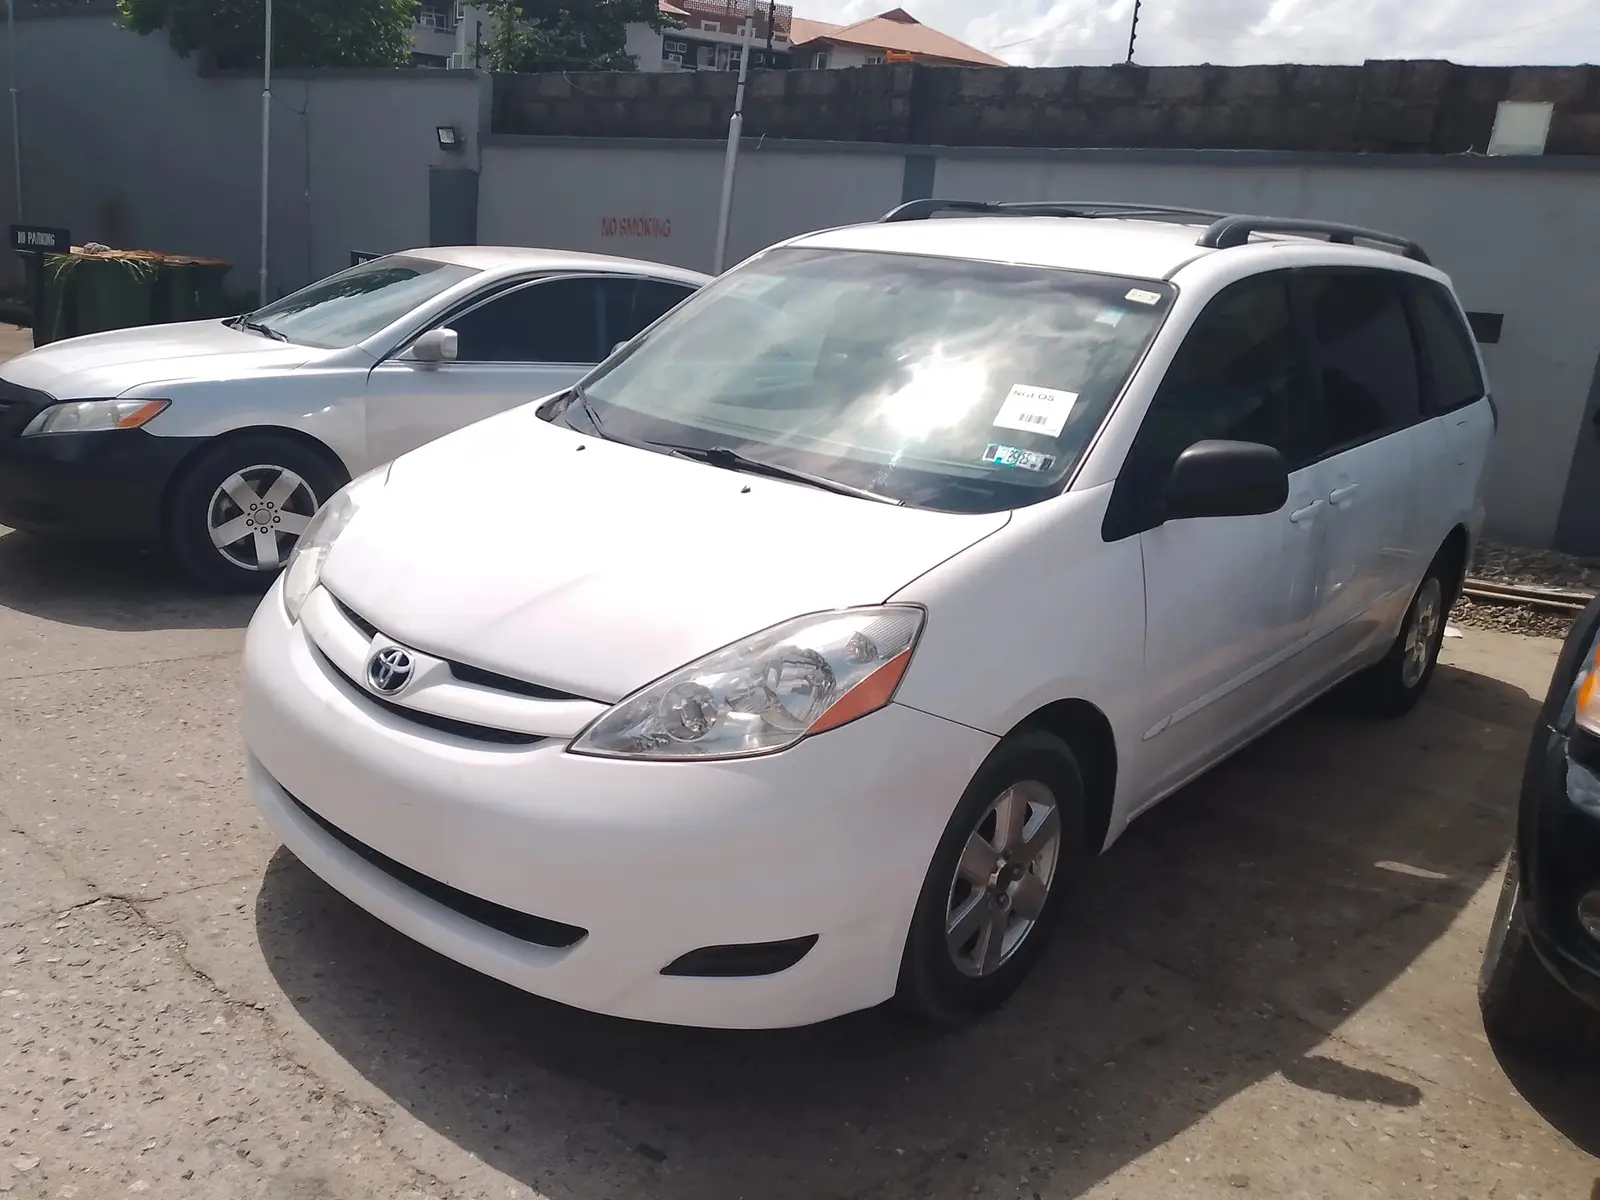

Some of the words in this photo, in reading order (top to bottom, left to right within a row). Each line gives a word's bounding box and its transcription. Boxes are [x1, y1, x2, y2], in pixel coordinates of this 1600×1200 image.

[601, 217, 617, 236] NO
[620, 217, 671, 237] SMOKING
[17, 231, 26, 244] NO
[27, 231, 56, 246] PARKING
